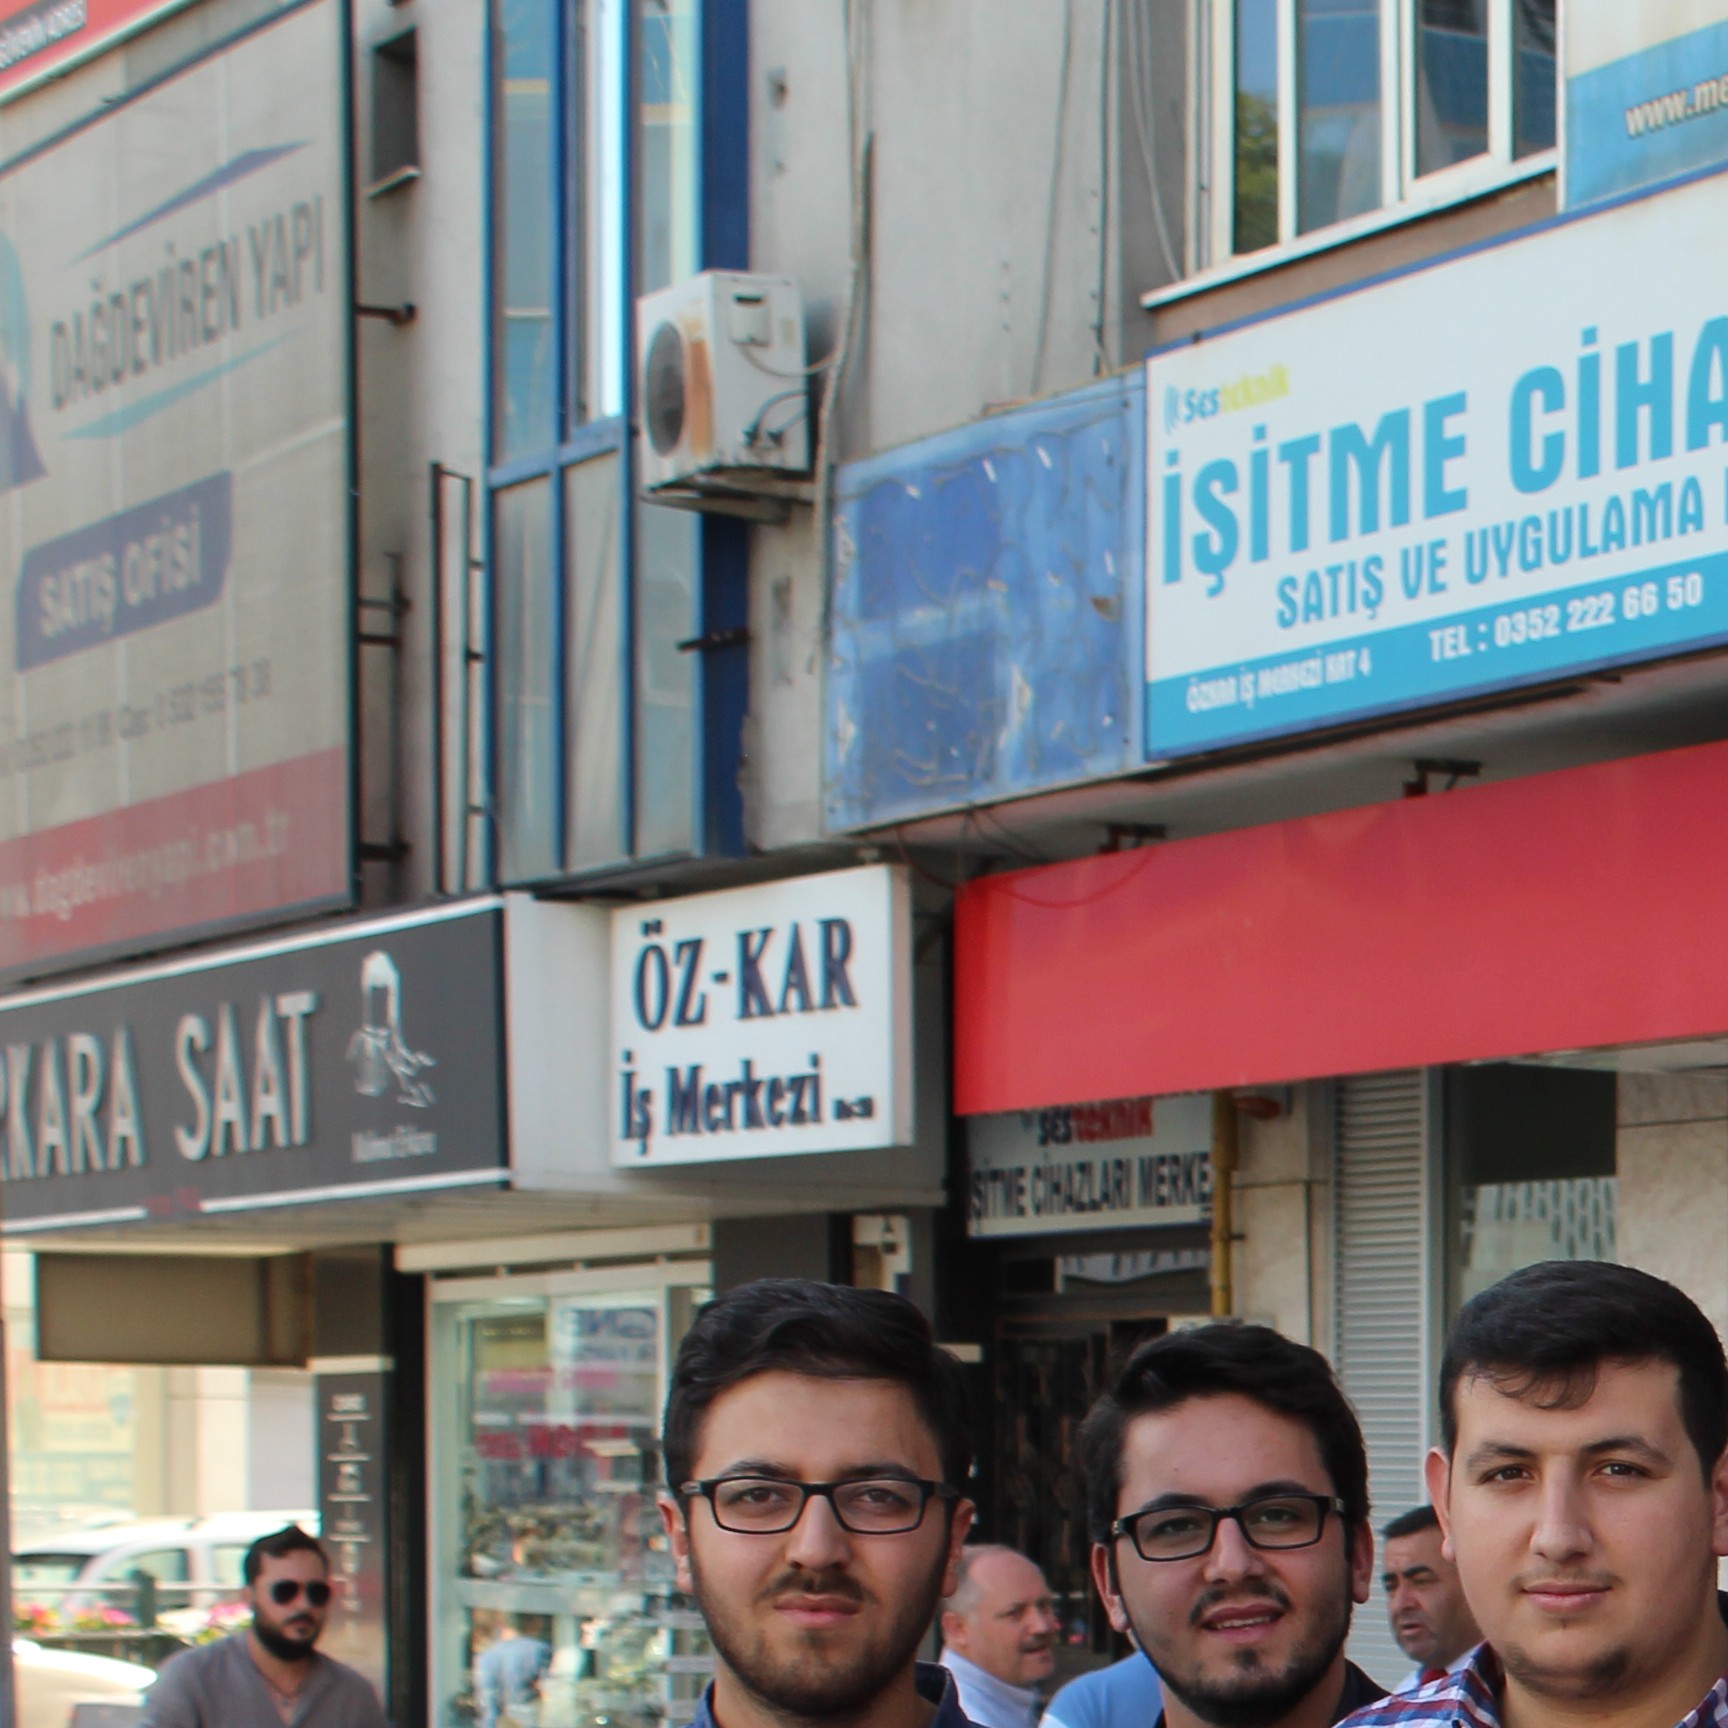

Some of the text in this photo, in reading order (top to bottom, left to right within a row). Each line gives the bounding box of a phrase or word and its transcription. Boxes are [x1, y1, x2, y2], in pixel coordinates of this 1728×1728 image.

[50, 191, 326, 412] DAĞDEVİREN YAPI
[121, 502, 202, 608] OFİSİ
[1162, 389, 1469, 599] İŞİTME
[1276, 554, 1385, 630] SATIŞ
[1400, 538, 1448, 601] VE
[1464, 473, 1705, 588] UYGULAMA
[1429, 625, 1472, 663] TEL
[1494, 603, 1561, 650] 0352
[1566, 593, 1616, 632] 222
[1623, 587, 1658, 621] 66
[1666, 571, 1704, 612] 50
[632, 917, 860, 1033] ÖZ-KAR
[174, 991, 319, 1162] SAAT
[620, 1048, 823, 1156] İş Merkezi
